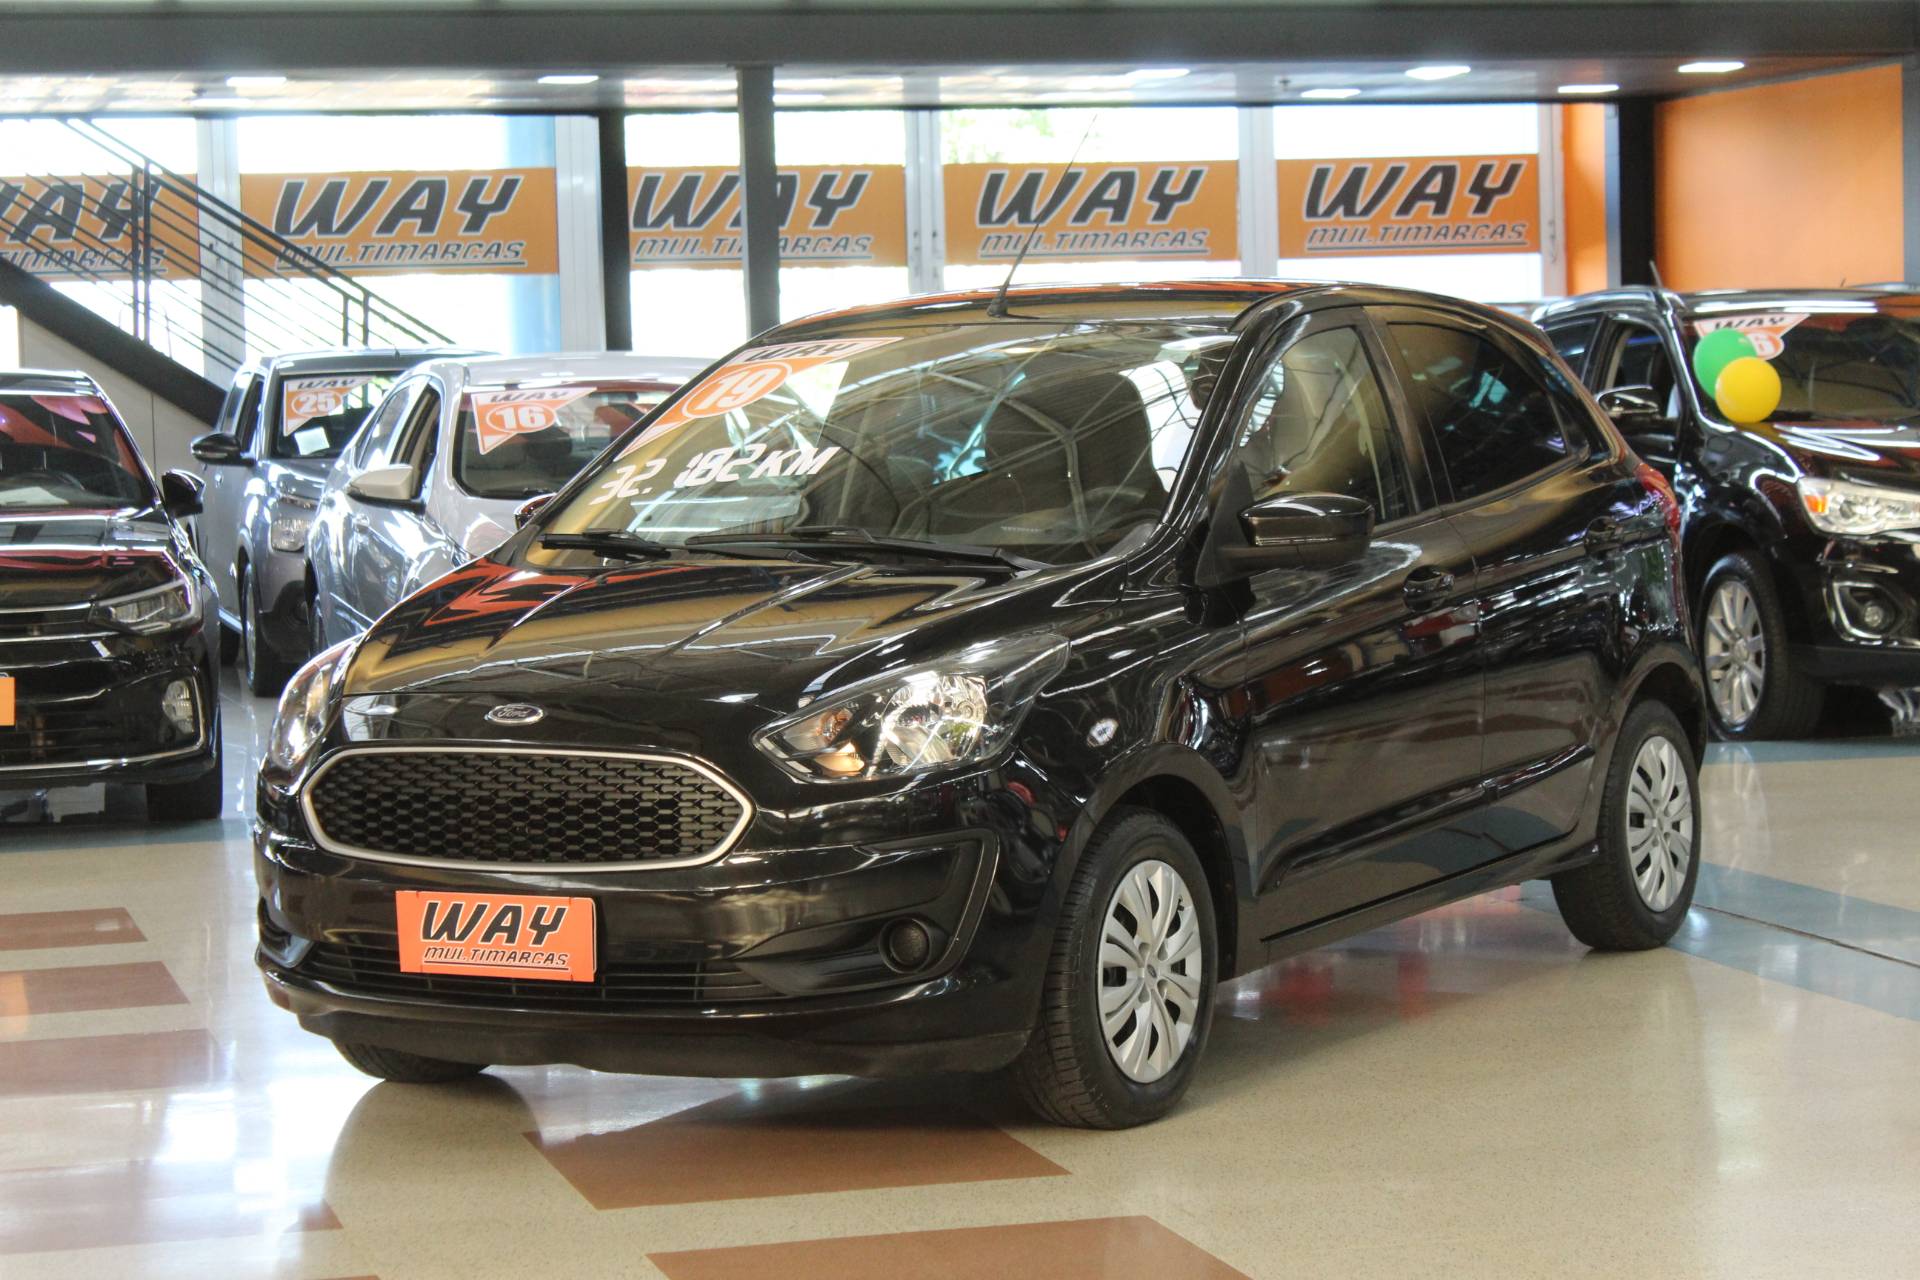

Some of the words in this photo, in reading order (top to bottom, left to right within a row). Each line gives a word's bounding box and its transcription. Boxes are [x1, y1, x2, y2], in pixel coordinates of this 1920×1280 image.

[978, 169, 1206, 225] WAY
[1304, 162, 1523, 219] WAY
[274, 177, 522, 237] WAY
[980, 230, 1209, 251] MULTIMARCAS
[1308, 224, 1527, 243] MULTIMARCAS
[635, 236, 872, 256] MULTIARCAS
[1714, 317, 1785, 330] WAY
[742, 342, 863, 363] WAY
[297, 379, 355, 390] WAY
[693, 367, 782, 411] 19
[490, 391, 568, 403] WAY
[495, 406, 547, 430] 16
[420, 901, 569, 947] WAY
[423, 946, 569, 966] MULTIMARCAS
